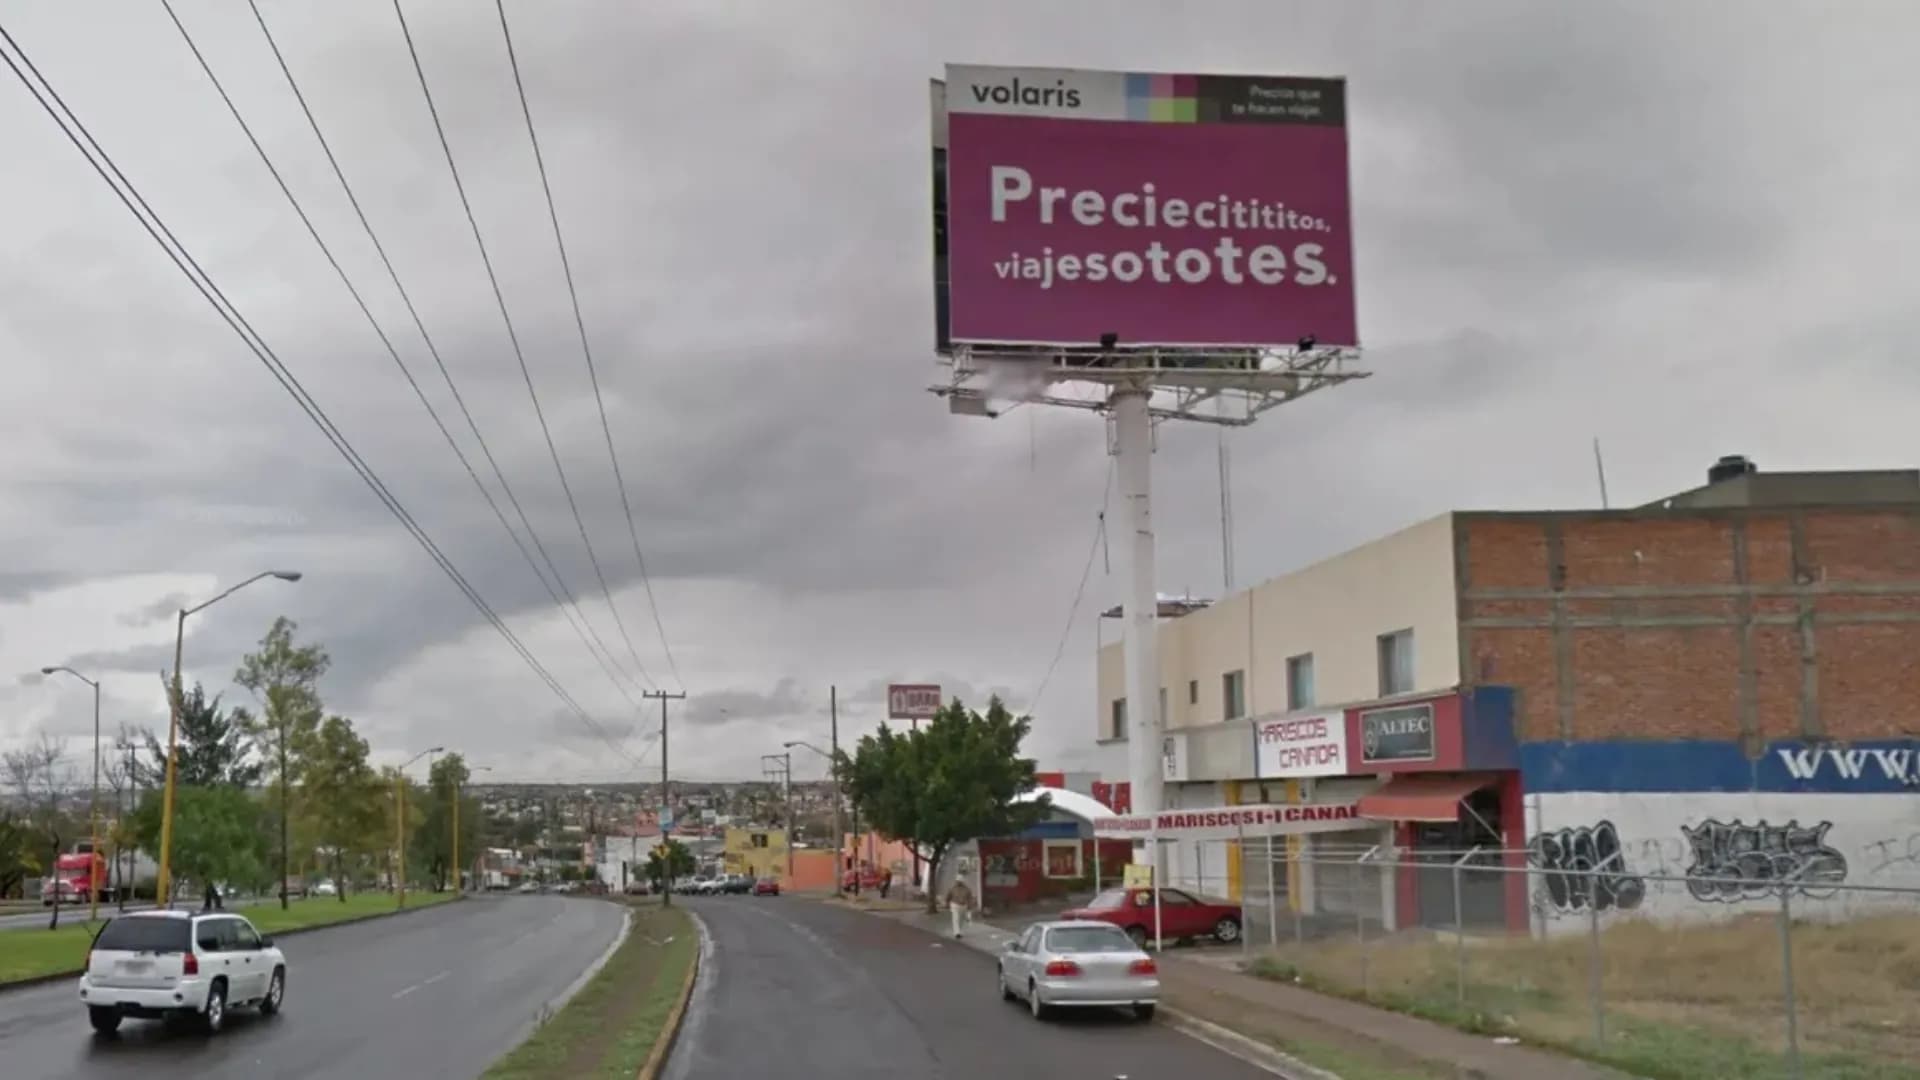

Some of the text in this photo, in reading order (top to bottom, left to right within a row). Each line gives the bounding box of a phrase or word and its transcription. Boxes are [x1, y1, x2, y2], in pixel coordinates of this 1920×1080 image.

[971, 77, 1081, 107] volaris
[991, 165, 1332, 232] Preciecitititos,
[994, 237, 1338, 289] viajesototes.
[1379, 716, 1430, 736] ALTEC
[1157, 811, 1255, 829] MARISCOS
